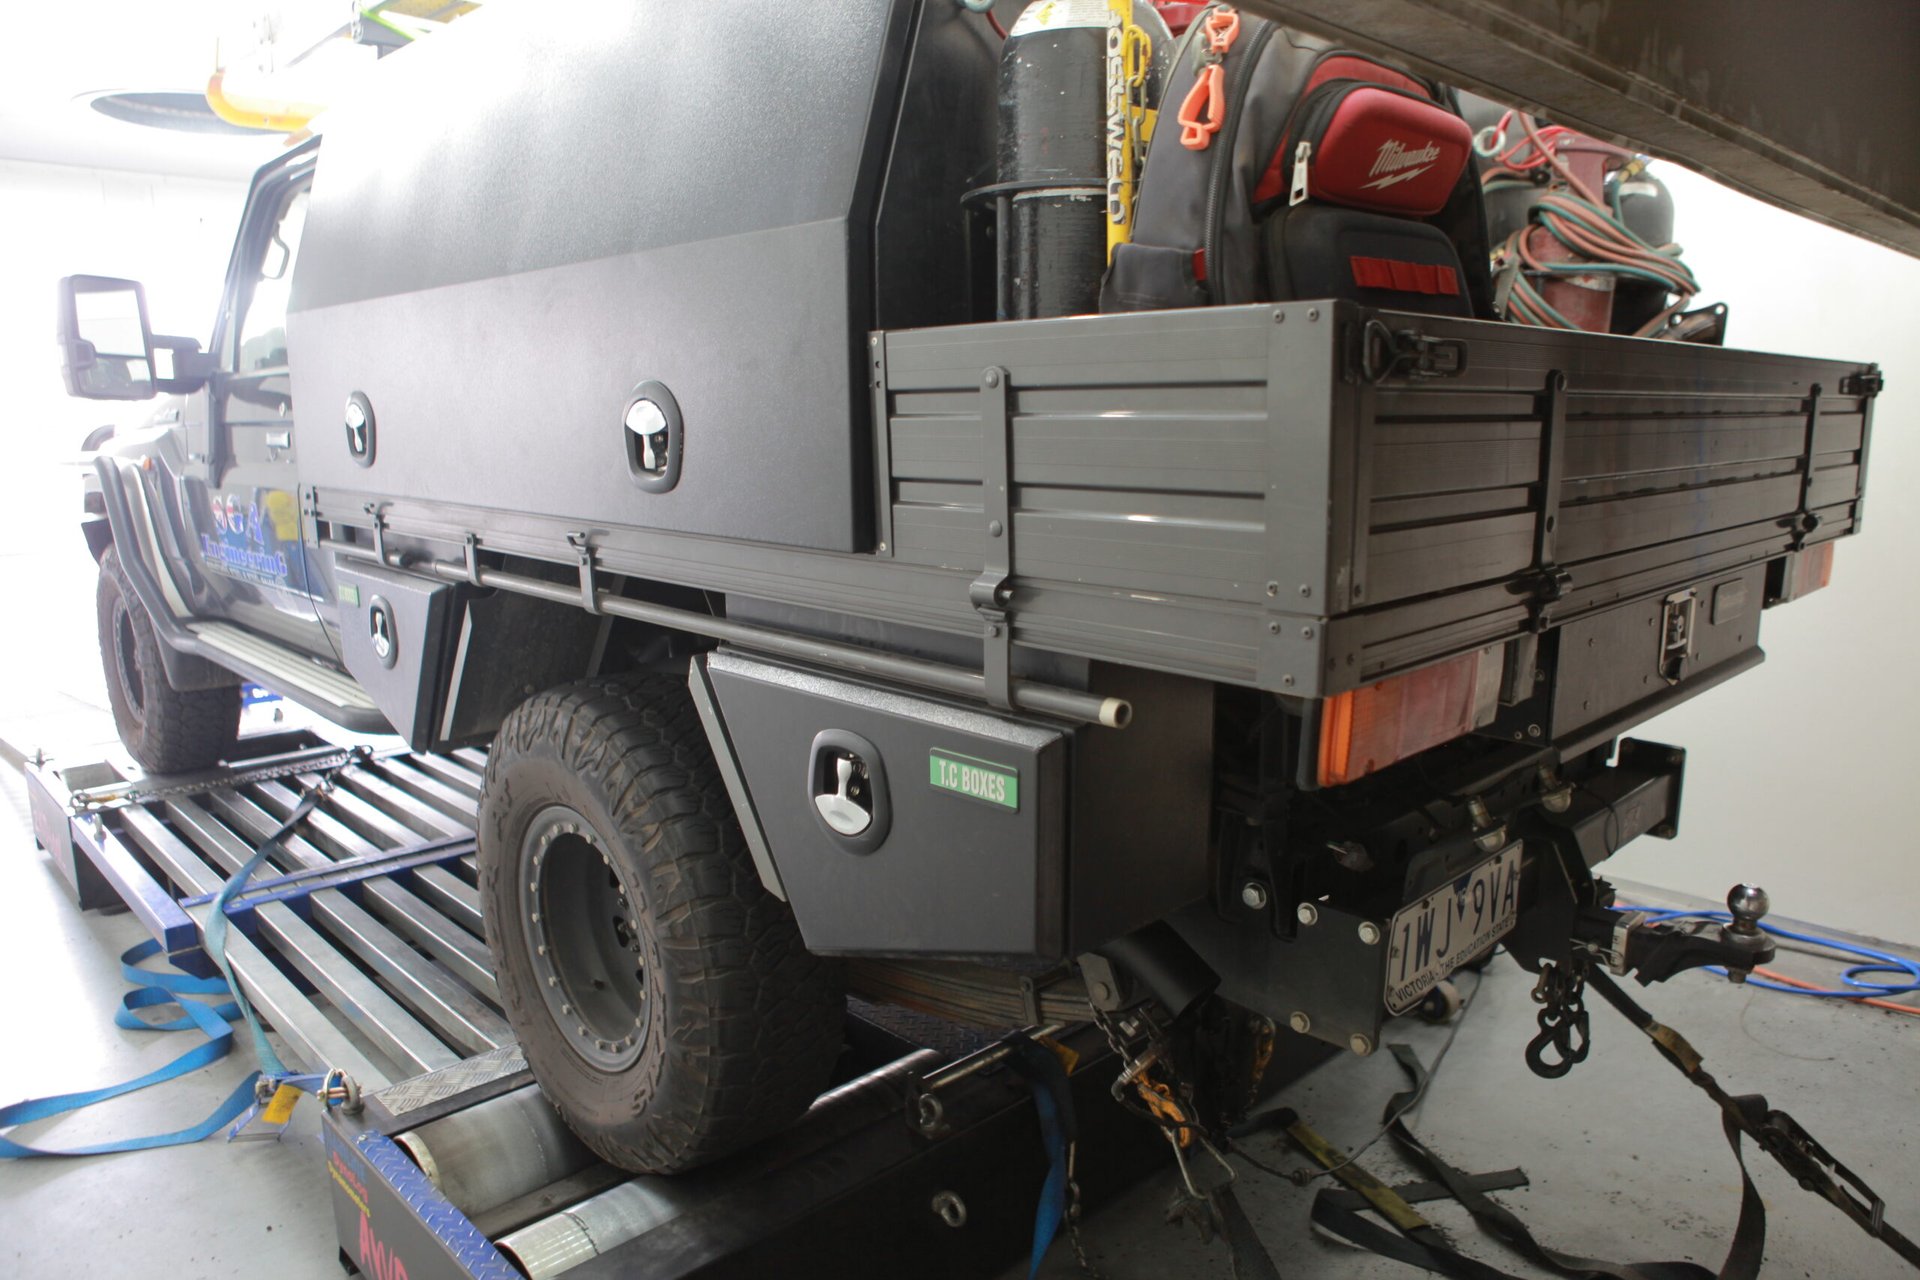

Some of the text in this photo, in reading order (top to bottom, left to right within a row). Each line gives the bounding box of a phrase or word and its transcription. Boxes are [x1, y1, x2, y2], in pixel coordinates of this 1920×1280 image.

[1369, 139, 1441, 177] Milwaukee
[961, 766, 1005, 802] BOXES
[1401, 859, 1515, 981] 1WJ 9VA
[1395, 971, 1437, 1001] VICTORIA
[1440, 956, 1456, 972] THE
[1455, 934, 1492, 963] EDUCATION
